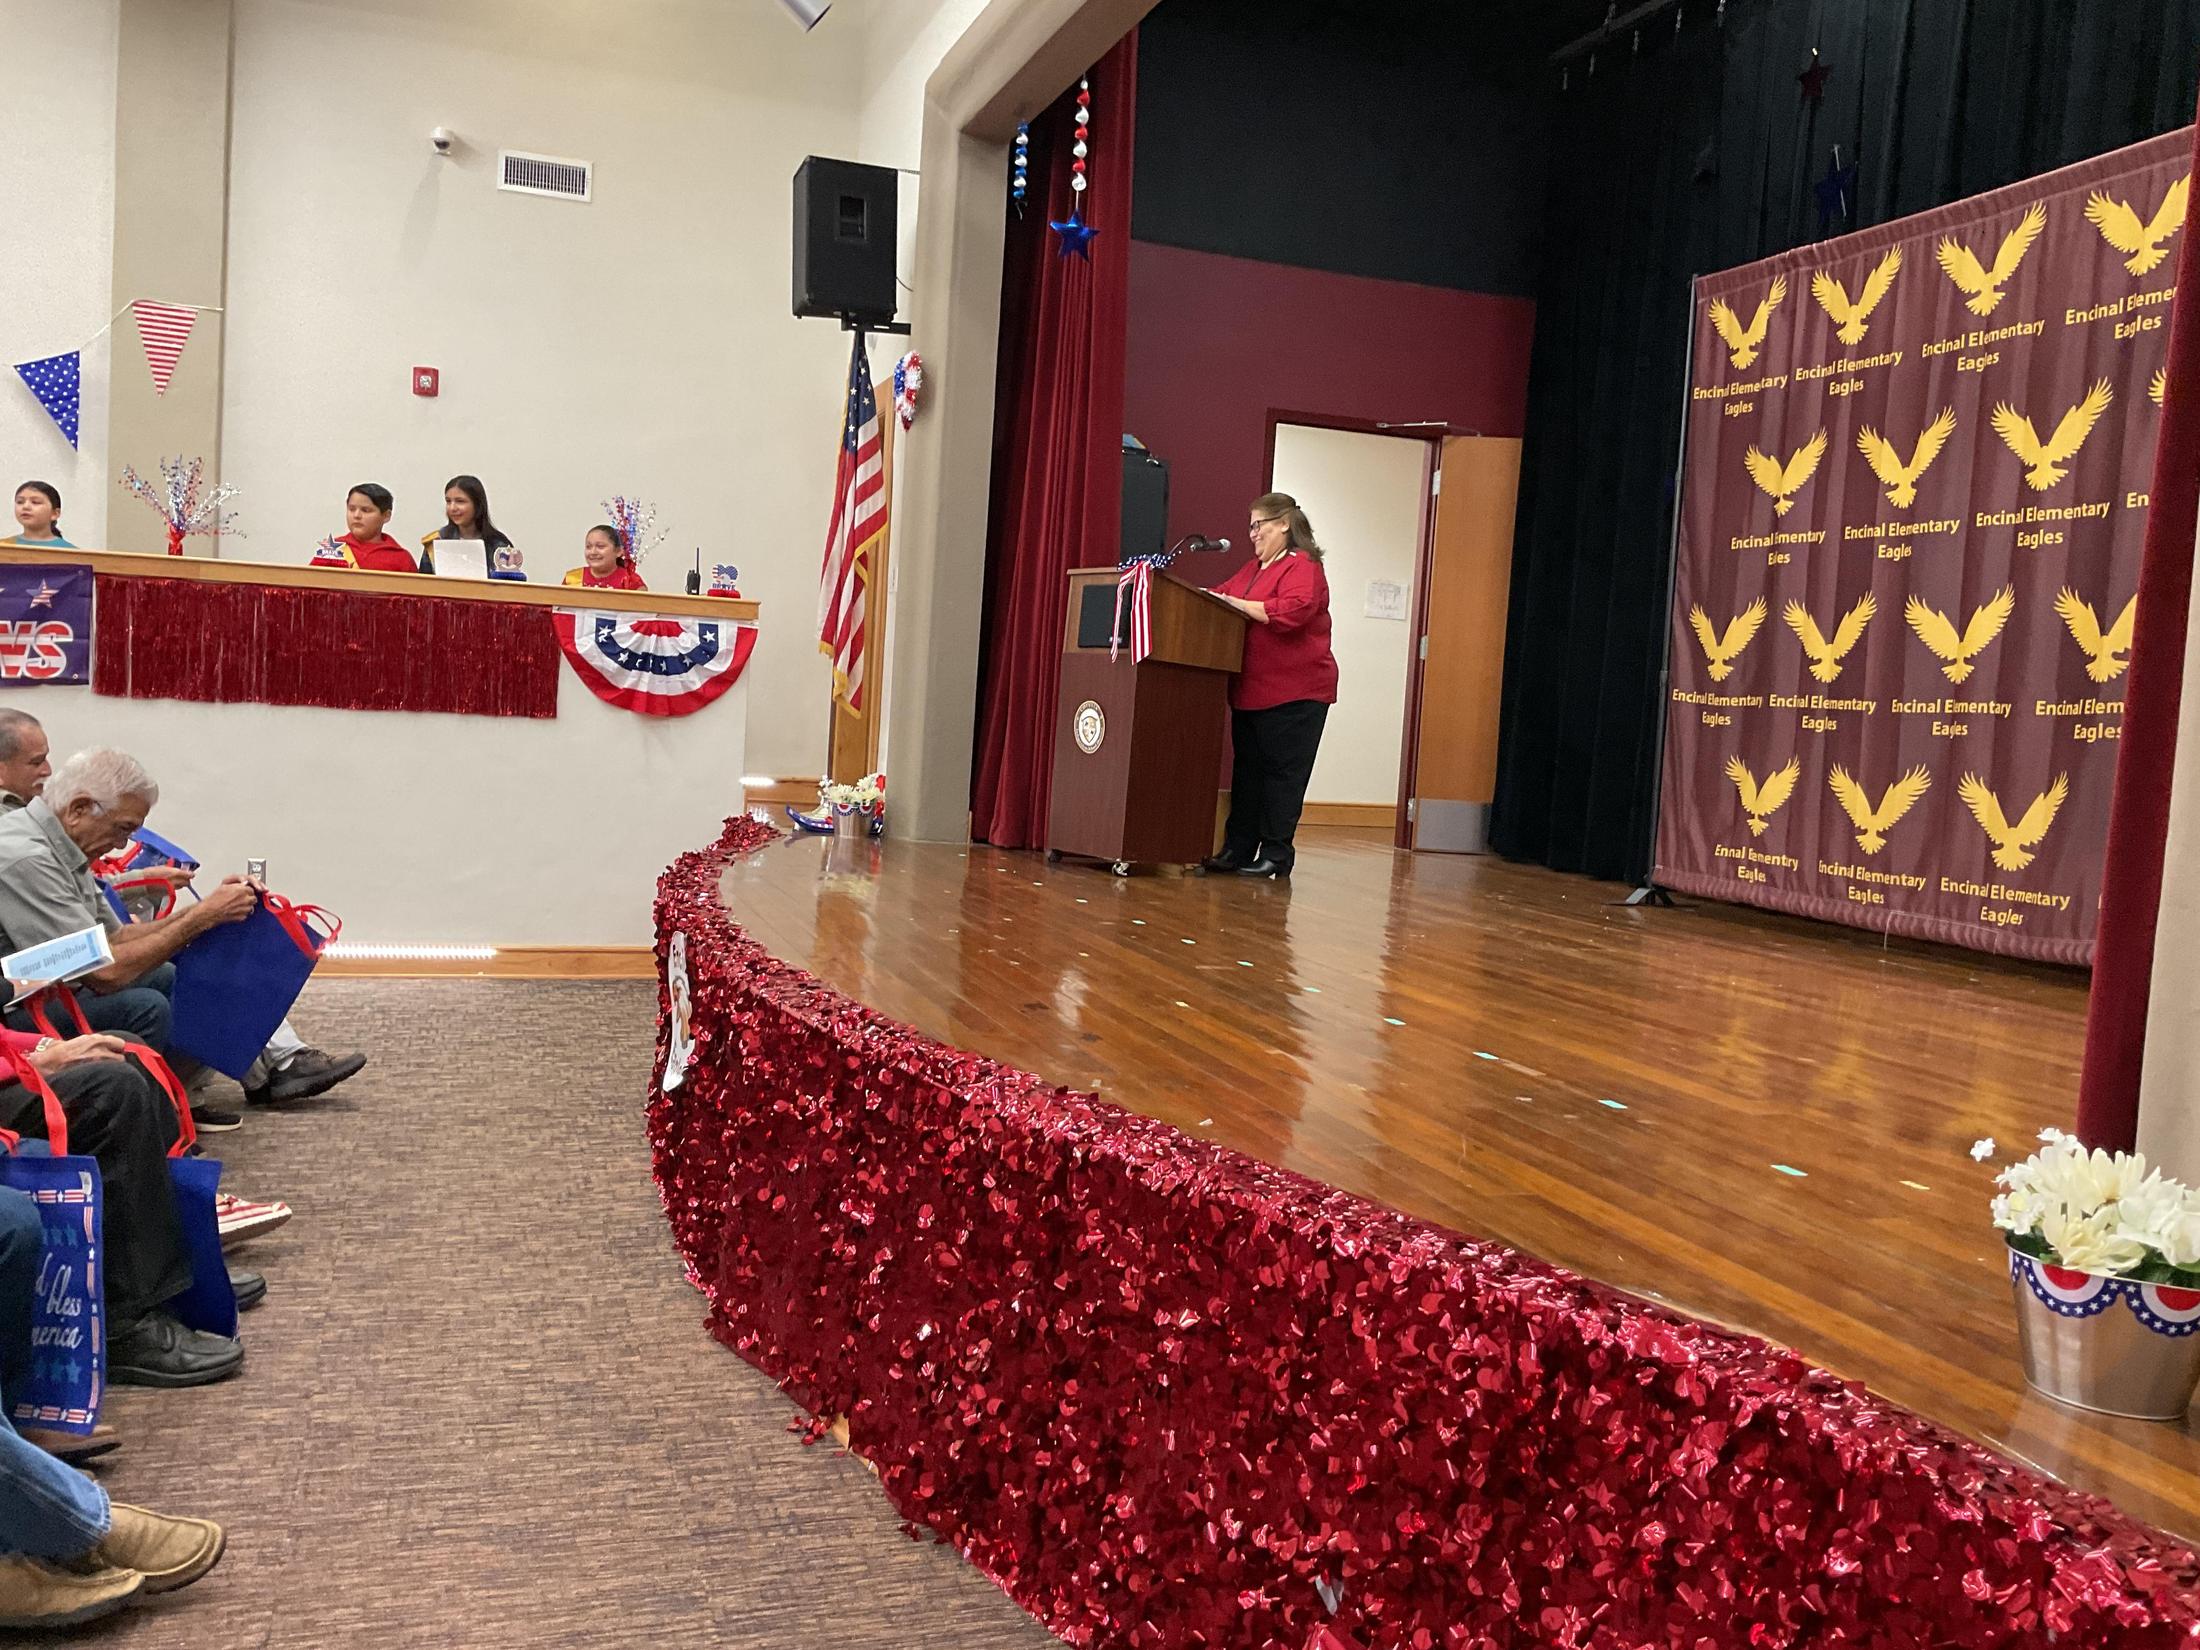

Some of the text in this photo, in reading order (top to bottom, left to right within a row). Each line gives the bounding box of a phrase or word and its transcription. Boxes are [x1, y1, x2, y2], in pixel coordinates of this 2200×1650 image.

[2065, 298, 2123, 325] Encinal
[2114, 314, 2162, 339] Eagles
[1922, 319, 2045, 358] Encinal Elementary
[1795, 351, 1903, 381] Encinal Elementary
[1957, 351, 2000, 373] Eagles
[1731, 375, 1788, 395] Elemetary
[1829, 378, 1864, 397] Eagles
[1725, 401, 1753, 417] Eagles
[1976, 502, 2110, 527] Encinal Elementary
[1844, 522, 1885, 540] Encinal
[2017, 529, 2063, 549] Eagles
[1731, 533, 1773, 550] Encinal
[1878, 543, 1912, 562] Eagles
[1672, 689, 1763, 708] Encinal Elementary
[1769, 694, 1877, 715] Encinal Elementary
[1891, 698, 1941, 714] Encinal
[2035, 699, 2083, 716] Encinal
[1702, 711, 1731, 728] Eagles
[1802, 715, 1837, 733] Eagles
[1738, 866, 1766, 884] Eagles
[1819, 859, 1927, 891] Encinal Elementary
[1848, 886, 1885, 905] Eagles
[1940, 877, 1989, 897] Encinal
[1990, 885, 2071, 911] Elementary
[1980, 906, 2024, 926] Eagles
[46, 1264, 82, 1317] bless
